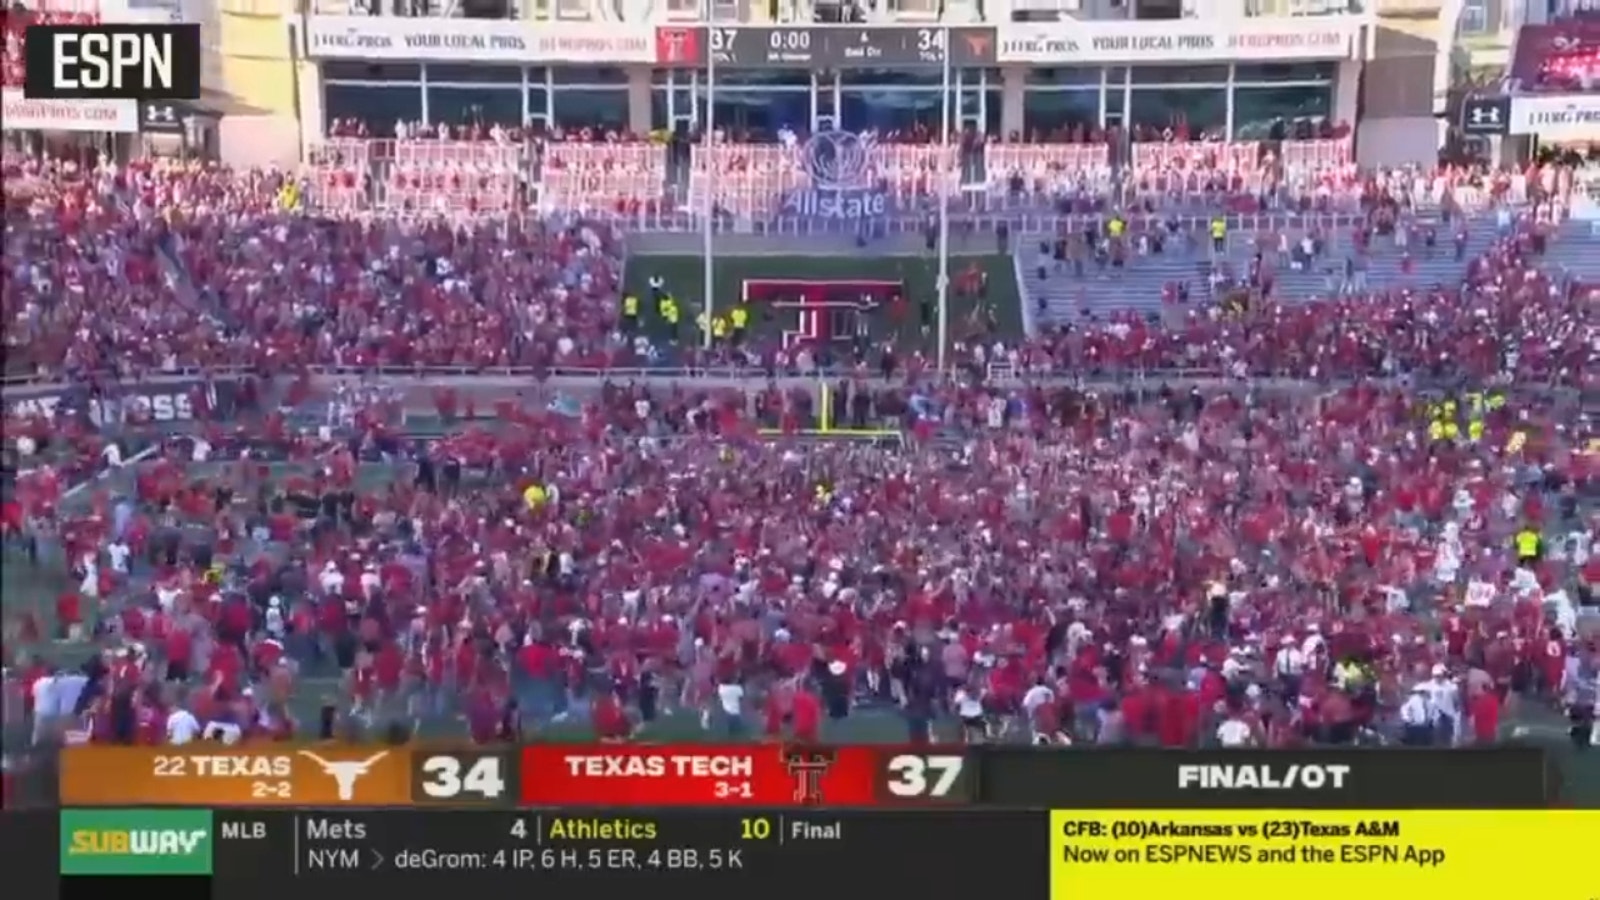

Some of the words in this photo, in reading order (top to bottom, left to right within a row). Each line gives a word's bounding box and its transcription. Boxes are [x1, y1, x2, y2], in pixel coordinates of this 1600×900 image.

[711, 29, 738, 50] 37
[770, 31, 811, 49] 0:00
[917, 29, 944, 50] 34
[1092, 35, 1129, 50] YOUR
[783, 189, 885, 219] Allstate
